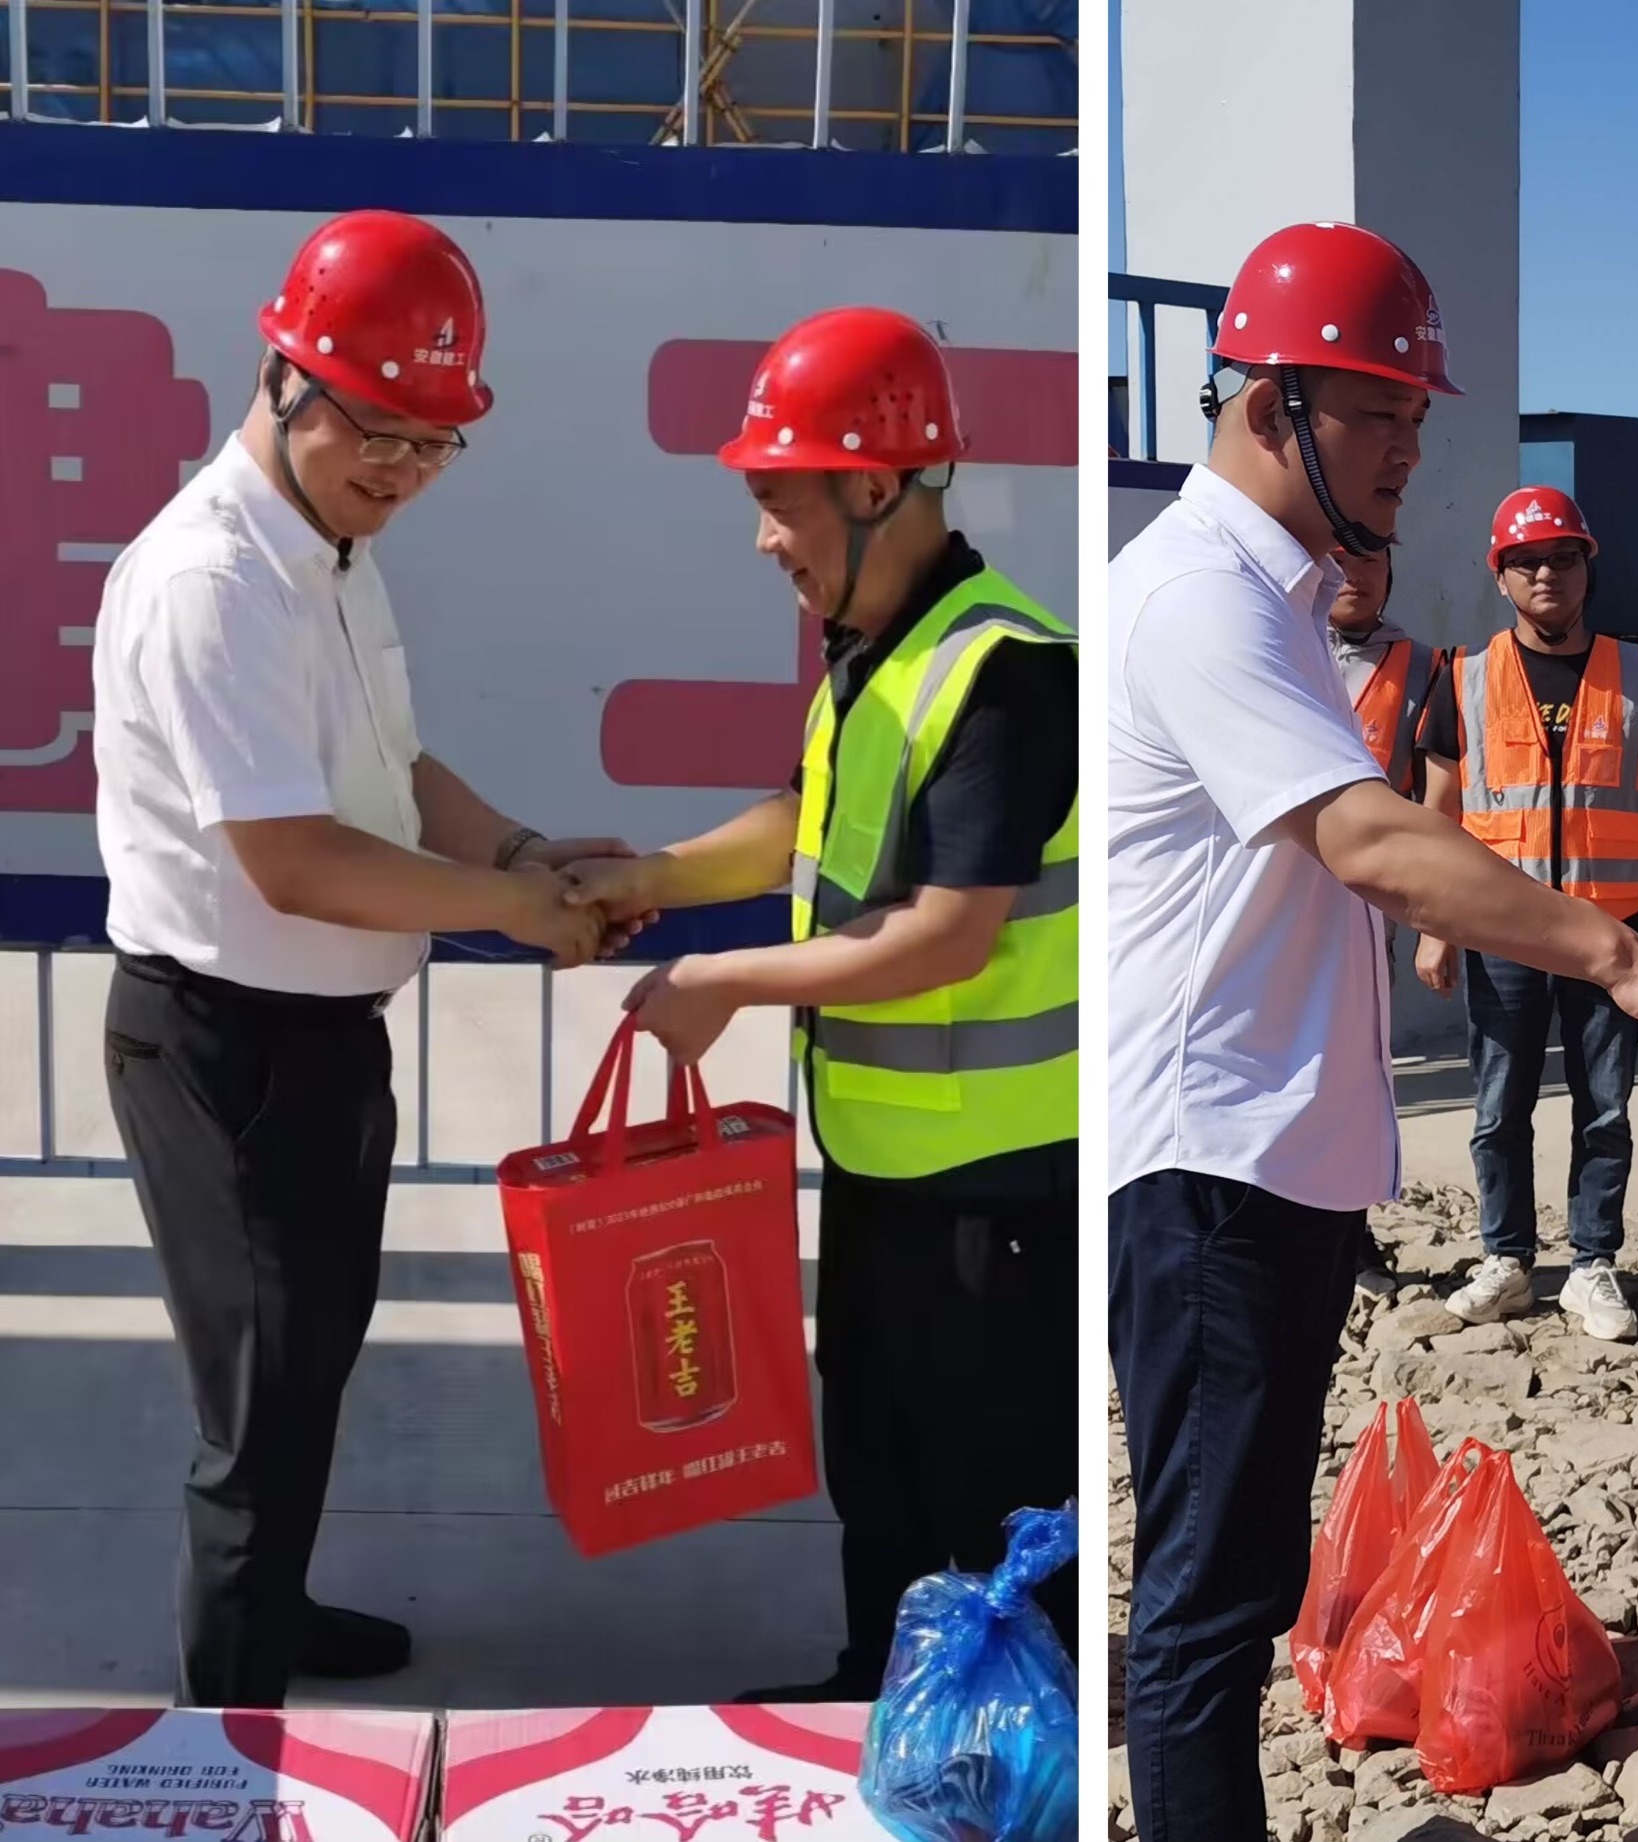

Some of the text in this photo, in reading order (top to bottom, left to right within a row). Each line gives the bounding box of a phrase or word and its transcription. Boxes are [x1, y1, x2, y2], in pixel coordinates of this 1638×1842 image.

[665, 1280, 700, 1397] 王老吉
[108, 1764, 241, 1776] FOR DRINKING
[625, 1765, 754, 1785] 饮用纯净水
[85, 1777, 249, 1790] PURIFIED WATER
[537, 1785, 846, 1842] 娃哈哈
